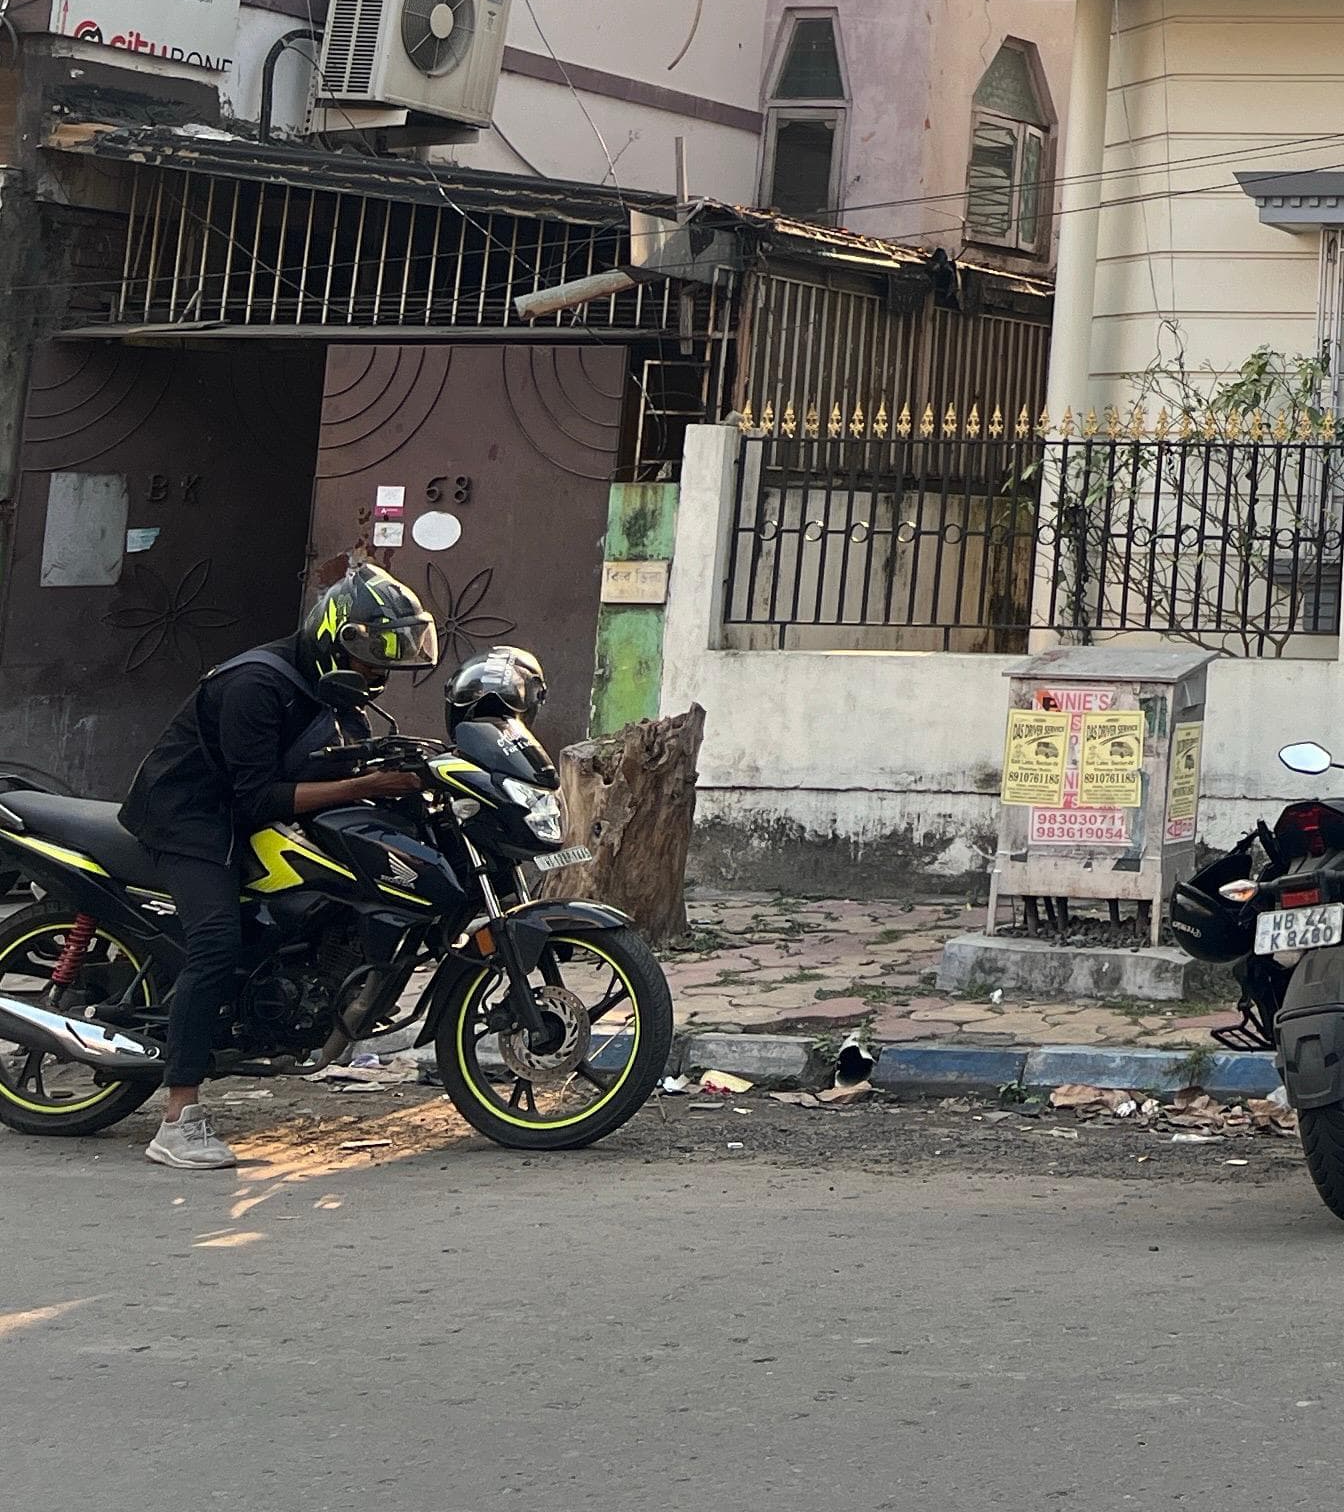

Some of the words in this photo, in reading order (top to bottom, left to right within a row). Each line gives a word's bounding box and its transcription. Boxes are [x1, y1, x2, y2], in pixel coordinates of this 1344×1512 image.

[426, 474, 472, 504] 68
[1012, 723, 1025, 741] DAS
[1025, 724, 1044, 739] DRIVER
[1044, 724, 1065, 735] SERVICE
[1098, 724, 1117, 739] DRIVER
[1008, 771, 1060, 785] 8910761185
[1084, 771, 1136, 785] 8910761185
[1273, 912, 1296, 931] WB
[1305, 908, 1328, 927] 44
[1270, 932, 1281, 951] K
